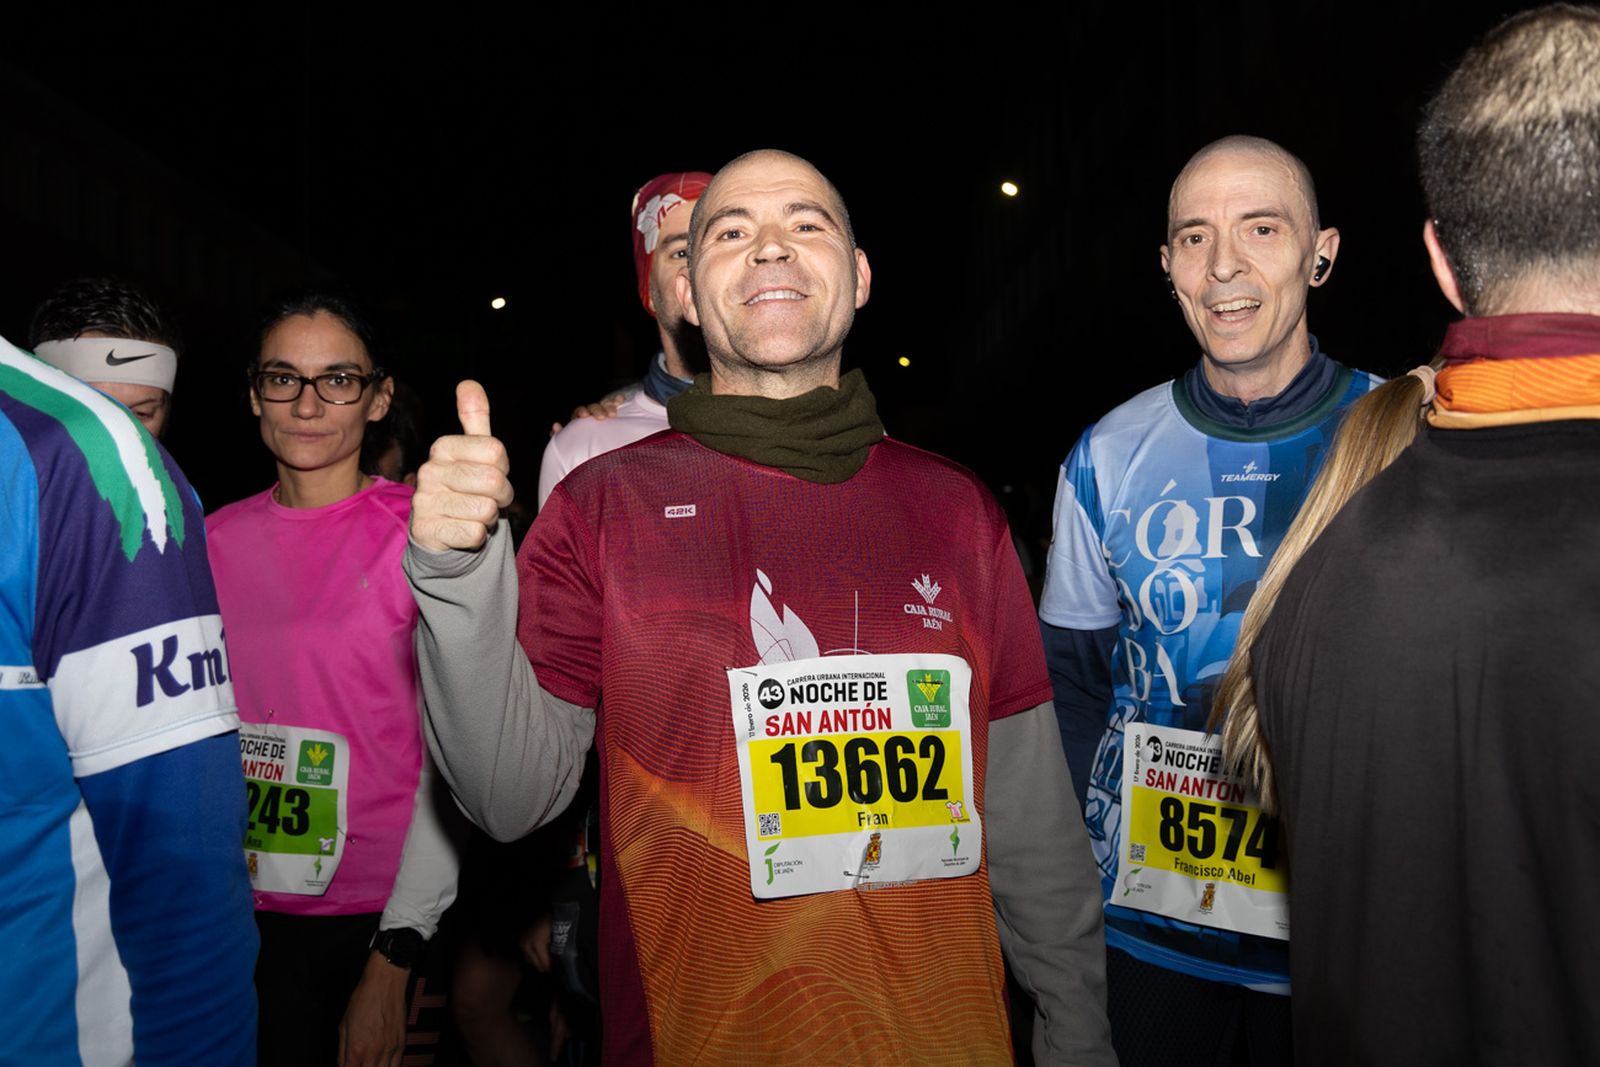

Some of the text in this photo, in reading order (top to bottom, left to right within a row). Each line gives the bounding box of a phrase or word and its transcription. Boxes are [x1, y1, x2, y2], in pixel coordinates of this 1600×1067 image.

[1220, 473, 1281, 482] TEAMERGY
[667, 507, 694, 516] 42K
[1103, 478, 1263, 569] CÓR
[904, 604, 953, 622] CAJA RURAL
[130, 626, 232, 708] Km
[787, 674, 816, 686] CARRERA
[842, 672, 885, 680] INTERNACIONAL
[760, 685, 783, 702] 43
[790, 681, 887, 704] NOCHE DE
[765, 702, 892, 737] SAN ANTÓN
[914, 705, 929, 713] CAJA
[240, 739, 286, 760] OCHE DE
[242, 759, 284, 781] ANTÓN
[770, 735, 948, 810] 13662
[1165, 749, 1219, 774] NOCHE
[1145, 768, 1245, 803] SAN ANTÓN
[858, 811, 888, 827] Fran
[1160, 797, 1279, 869] 8574
[1174, 857, 1255, 885] Francisco Abel
